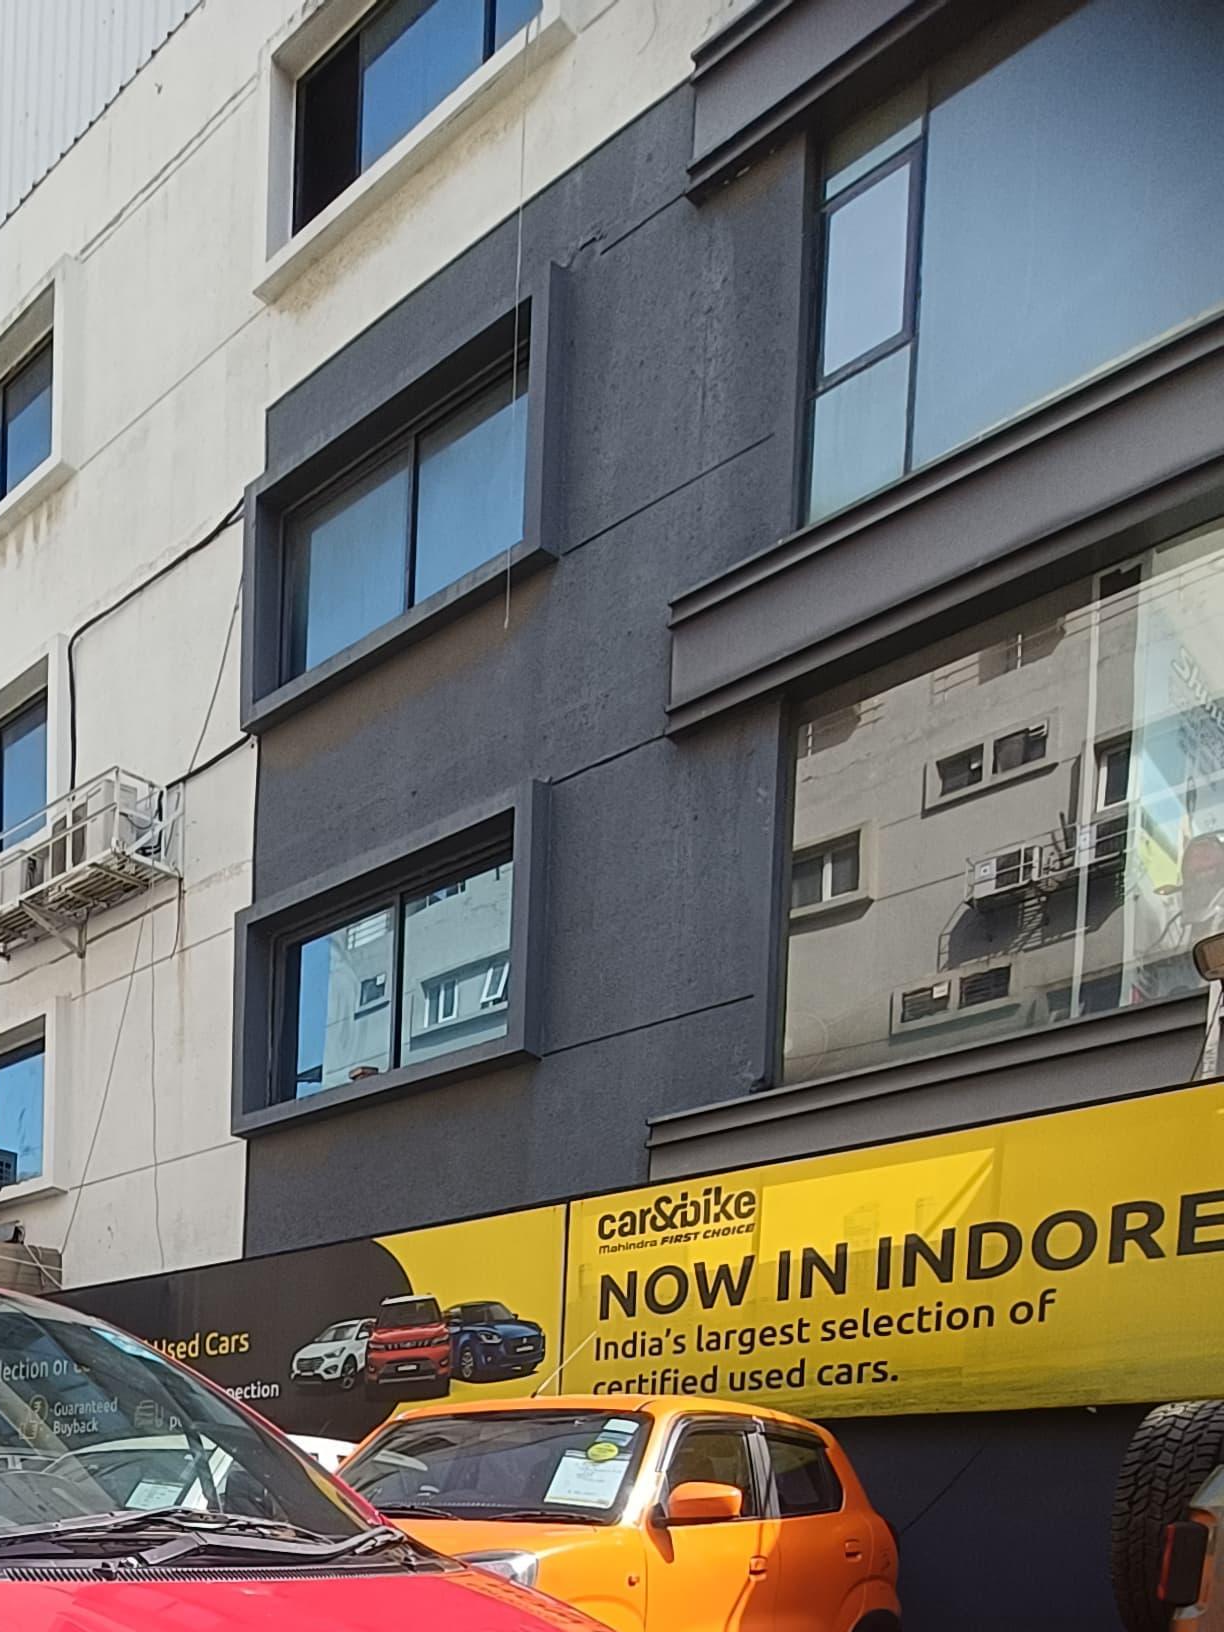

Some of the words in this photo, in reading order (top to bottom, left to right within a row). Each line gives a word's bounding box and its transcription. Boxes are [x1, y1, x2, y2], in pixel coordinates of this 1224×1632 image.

[598, 1186, 756, 1240] car&bike
[598, 1239, 658, 1255] Mahindra
[660, 1231, 700, 1246] FIRST
[703, 1223, 756, 1240] CHOICE
[599, 1254, 756, 1321] NOW
[776, 1241, 849, 1301] IN
[876, 1189, 1224, 1291] INDORE
[696, 1317, 811, 1360] largest
[820, 1301, 995, 1344] selection
[1008, 1288, 1056, 1325] of
[205, 1331, 250, 1356] Cars
[593, 1364, 718, 1395] certified
[728, 1358, 806, 1392] used
[817, 1358, 899, 1387] cars.
[53, 1416, 99, 1438] Buyback
